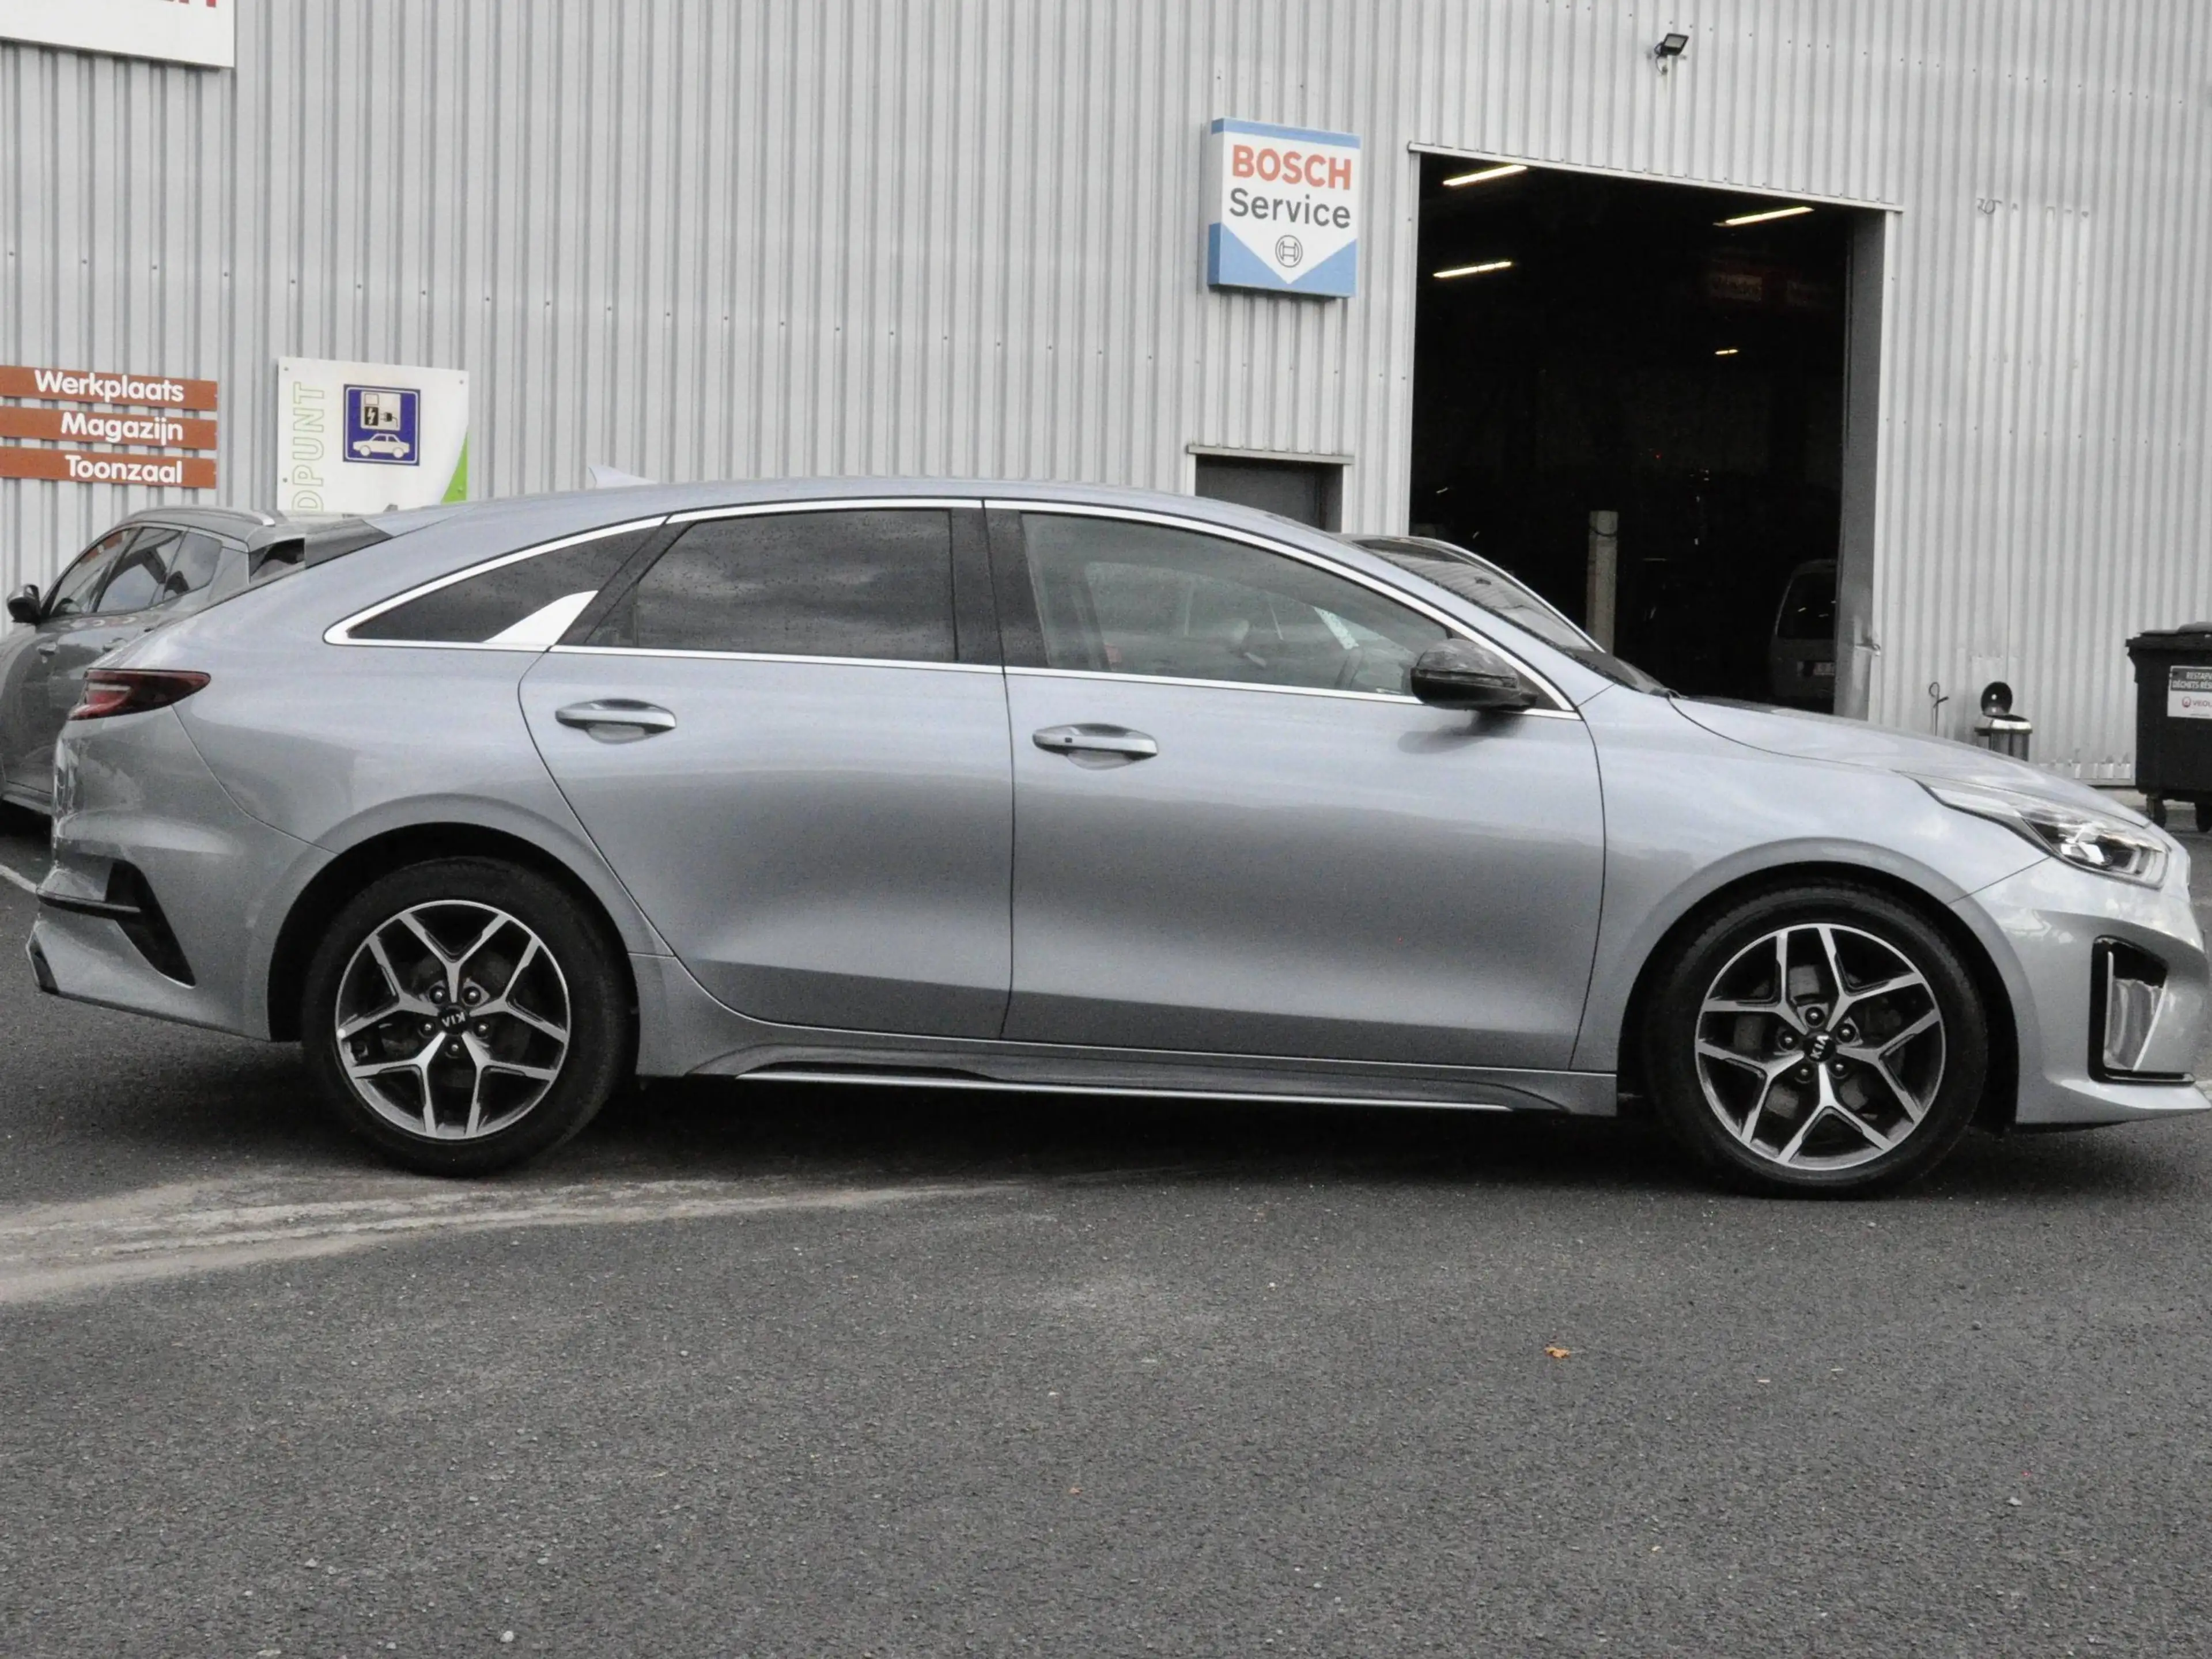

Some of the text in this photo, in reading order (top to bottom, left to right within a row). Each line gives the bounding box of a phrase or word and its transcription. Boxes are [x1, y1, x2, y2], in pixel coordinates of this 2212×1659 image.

[1232, 145, 1351, 190] BOSCH
[1229, 188, 1351, 229] Service
[35, 369, 184, 403] Werkplaats
[61, 412, 183, 445] Magazijn
[65, 454, 183, 483] Toonzaal
[441, 1012, 466, 1027] KIA
[1810, 1035, 1830, 1059] KIA
